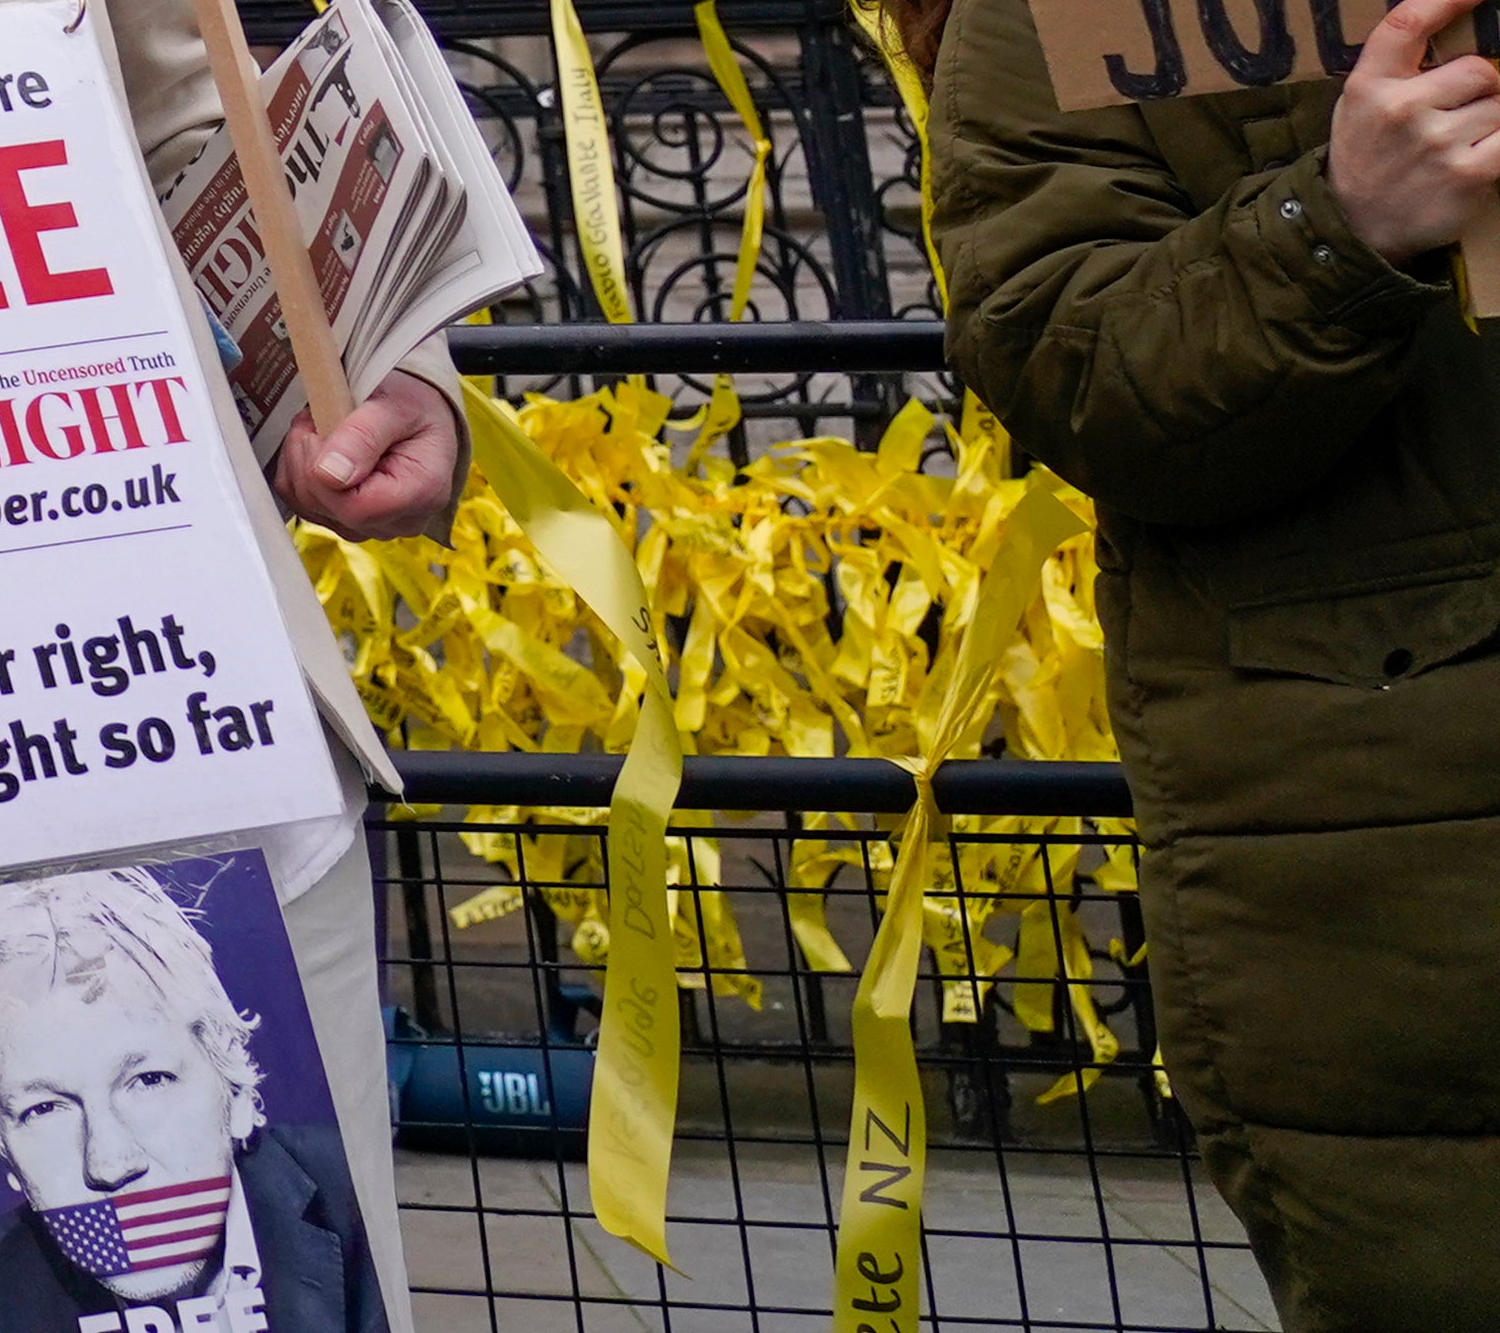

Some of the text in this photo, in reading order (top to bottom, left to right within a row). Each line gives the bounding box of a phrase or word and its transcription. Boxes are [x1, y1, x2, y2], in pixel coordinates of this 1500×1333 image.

[23, 356, 128, 389] Uncensored
[128, 350, 177, 373] Truth
[33, 611, 217, 699] right,
[101, 715, 177, 771] so
[186, 690, 276, 753] far
[477, 1071, 552, 1116] JBL
[859, 1101, 911, 1210] NZ
